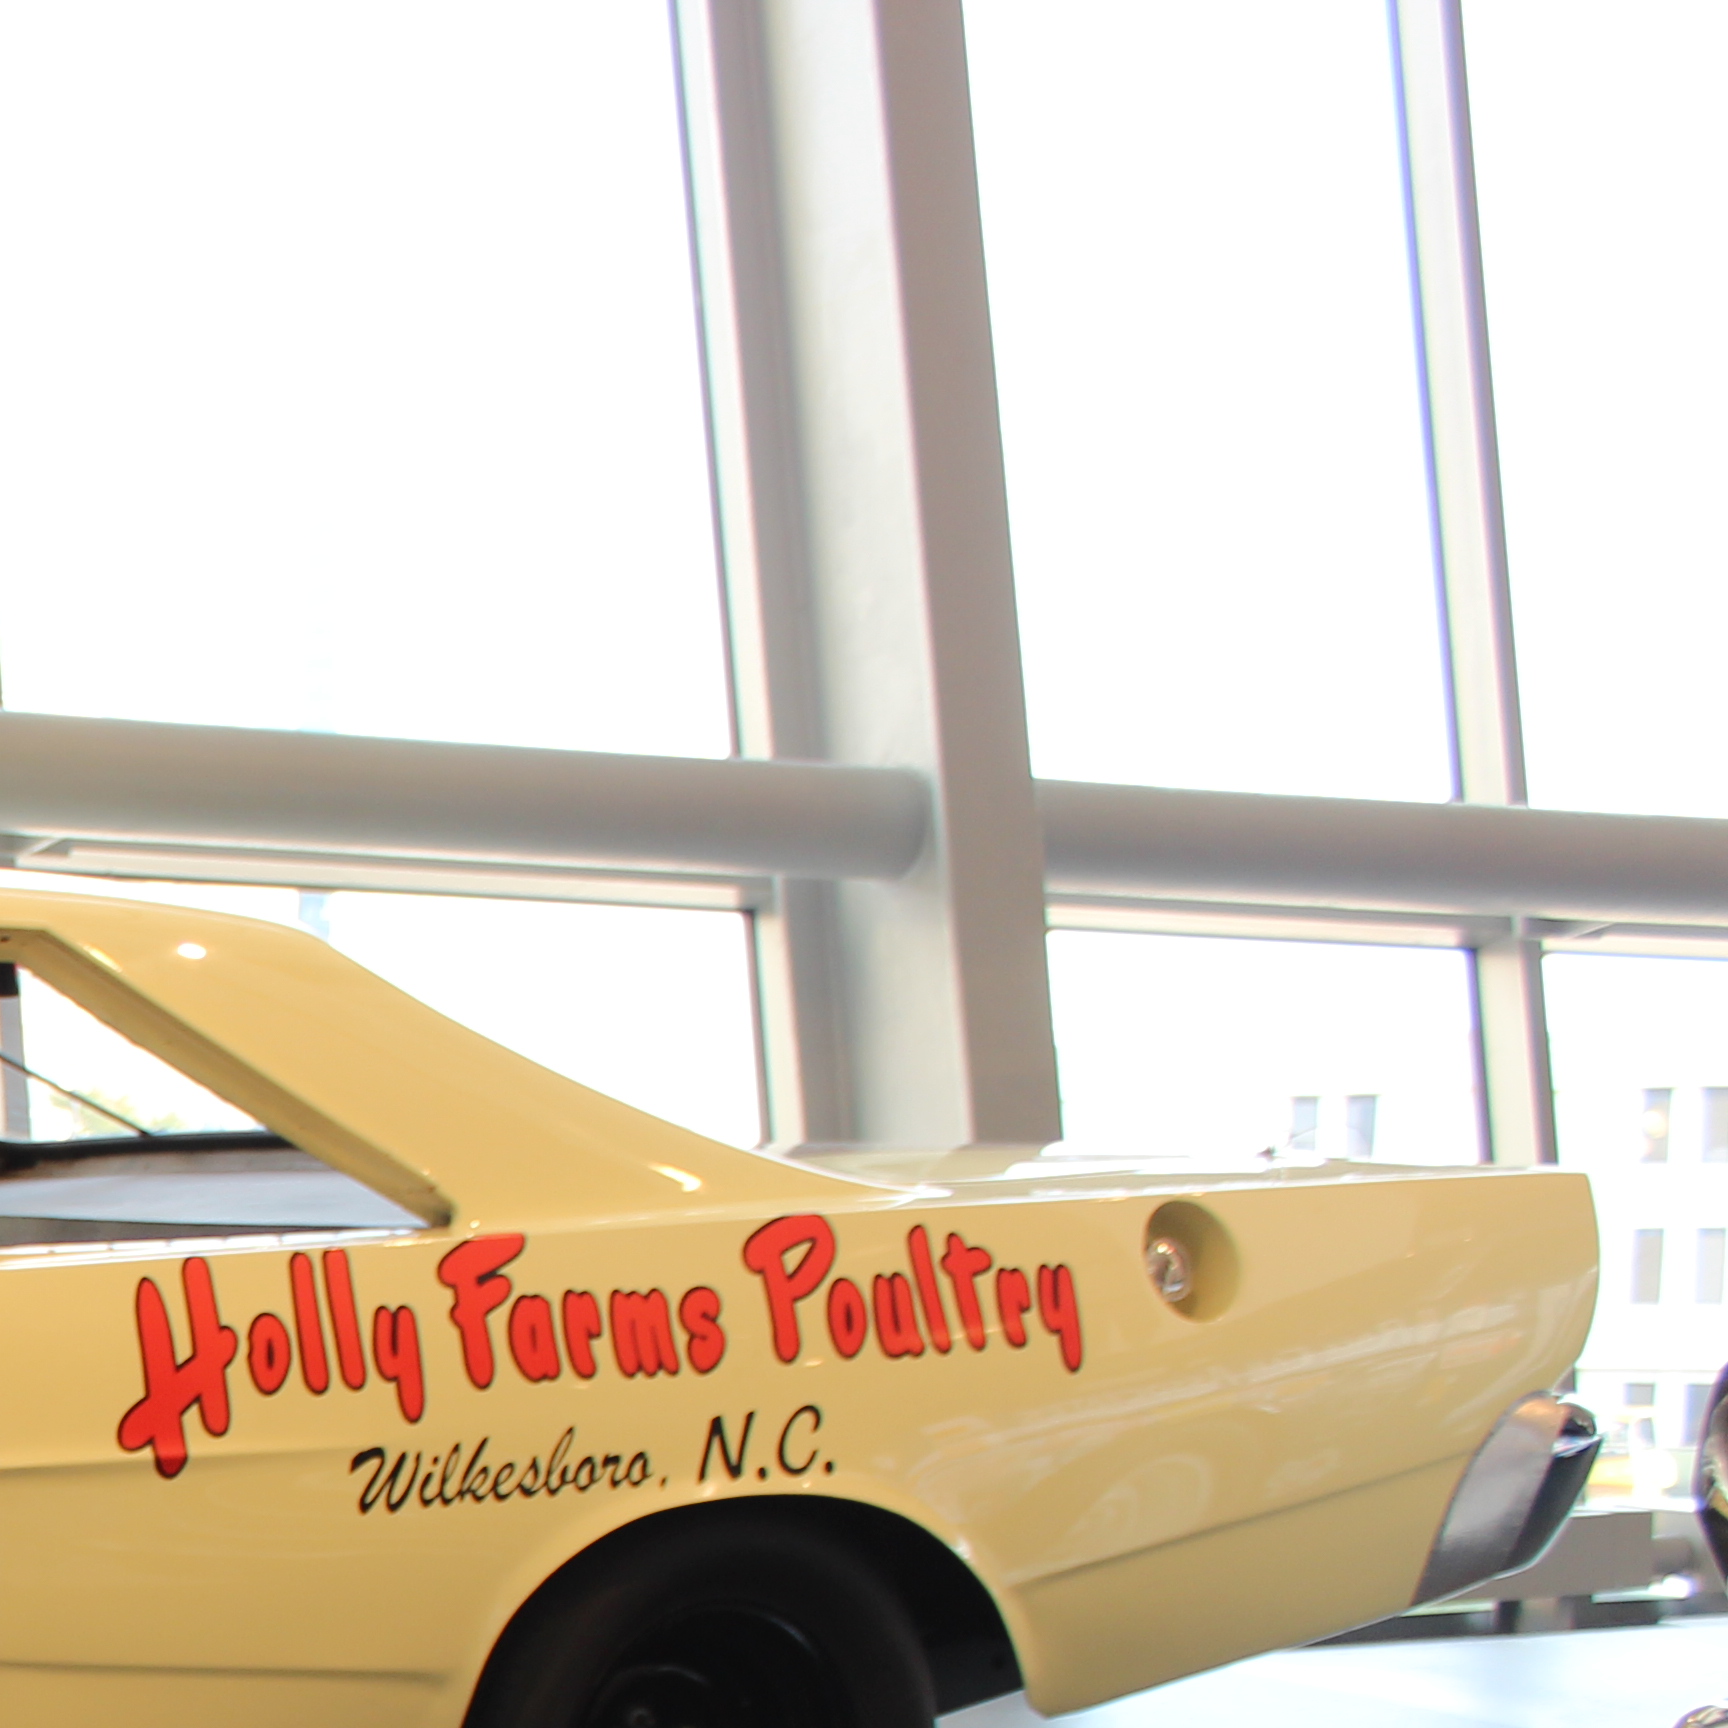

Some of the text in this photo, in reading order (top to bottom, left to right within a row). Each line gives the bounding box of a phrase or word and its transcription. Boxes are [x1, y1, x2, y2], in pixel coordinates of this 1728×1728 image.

[117, 1213, 1084, 1479] Holly Farms Poultry
[695, 1403, 835, 1483] N.C.
